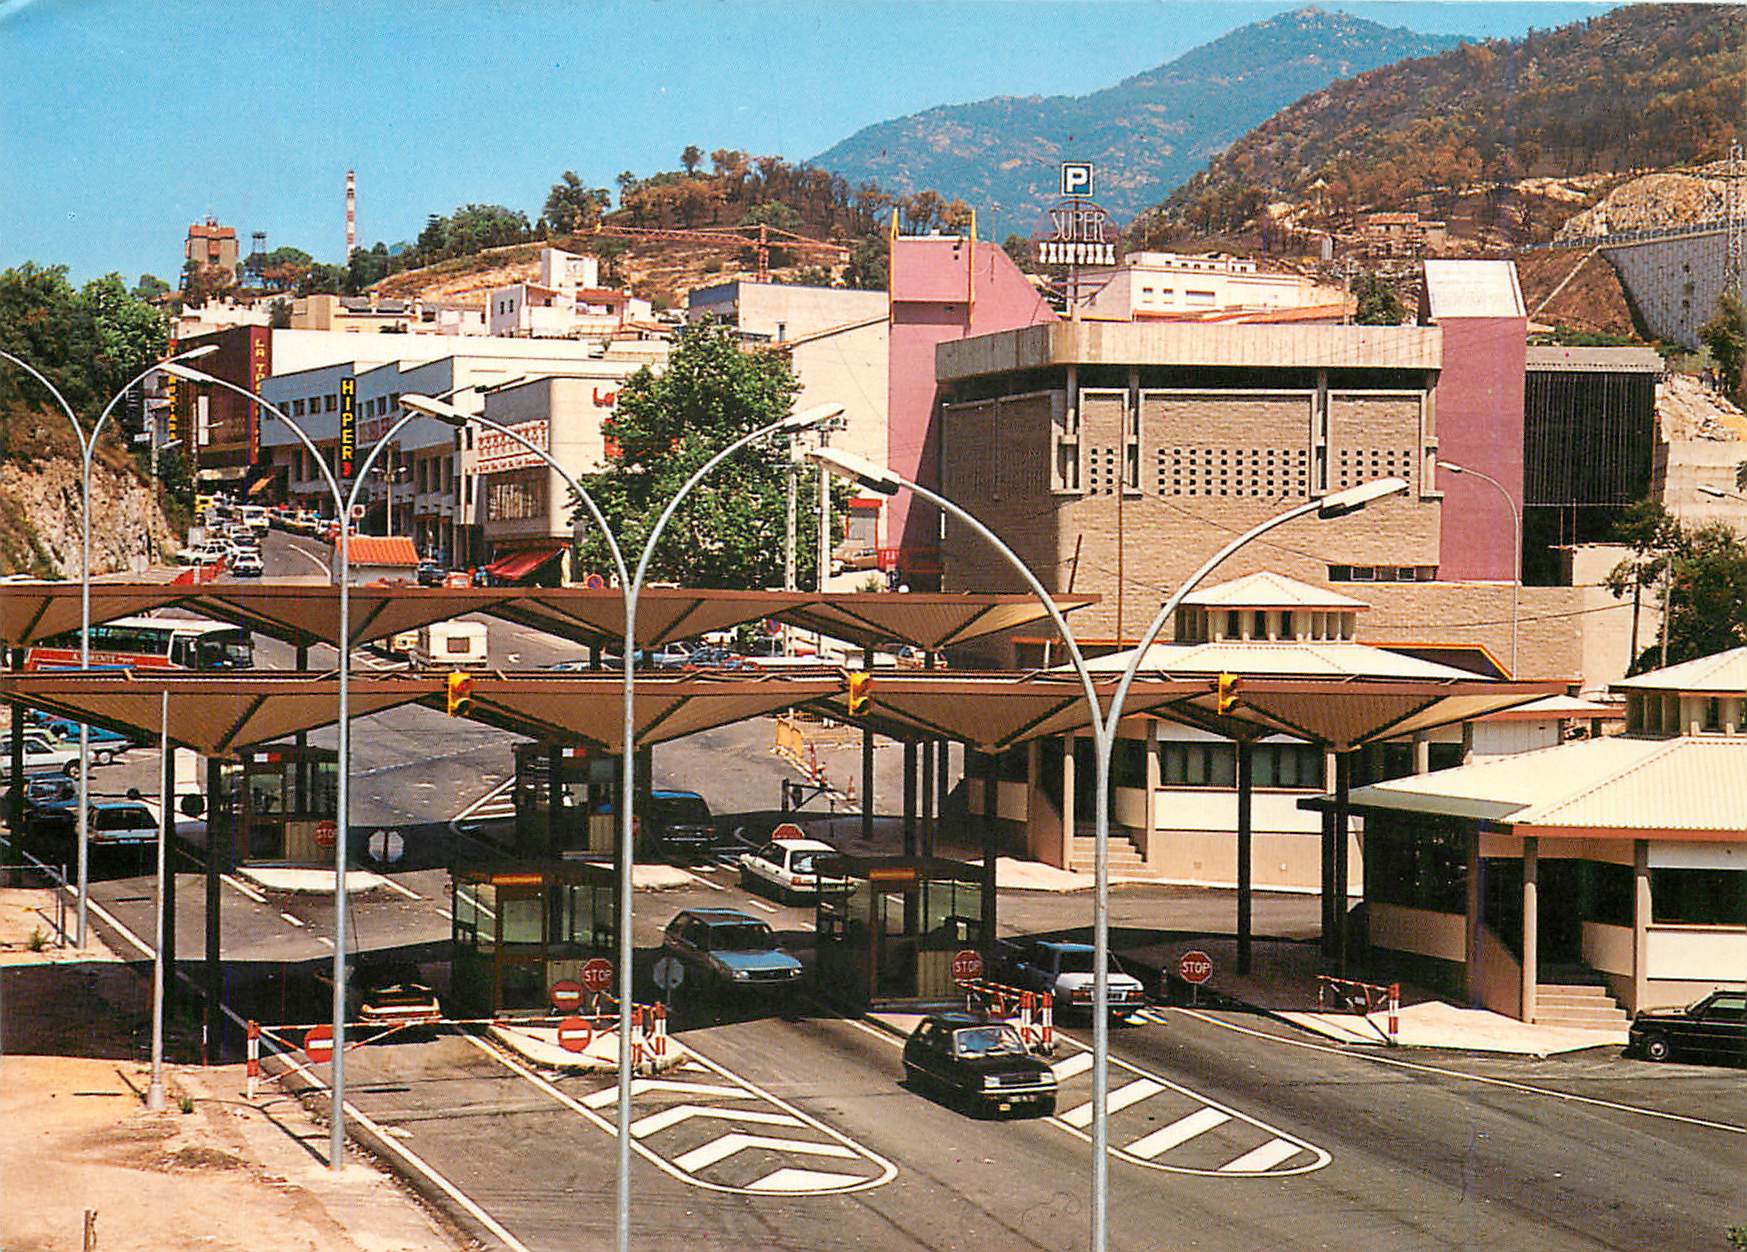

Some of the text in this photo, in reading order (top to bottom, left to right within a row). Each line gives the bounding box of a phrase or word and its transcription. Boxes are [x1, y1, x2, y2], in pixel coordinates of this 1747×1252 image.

[1066, 167, 1088, 193] P
[1050, 209, 1106, 243] SUPER
[342, 380, 354, 460] HIPER
[1182, 961, 1211, 974] STOP
